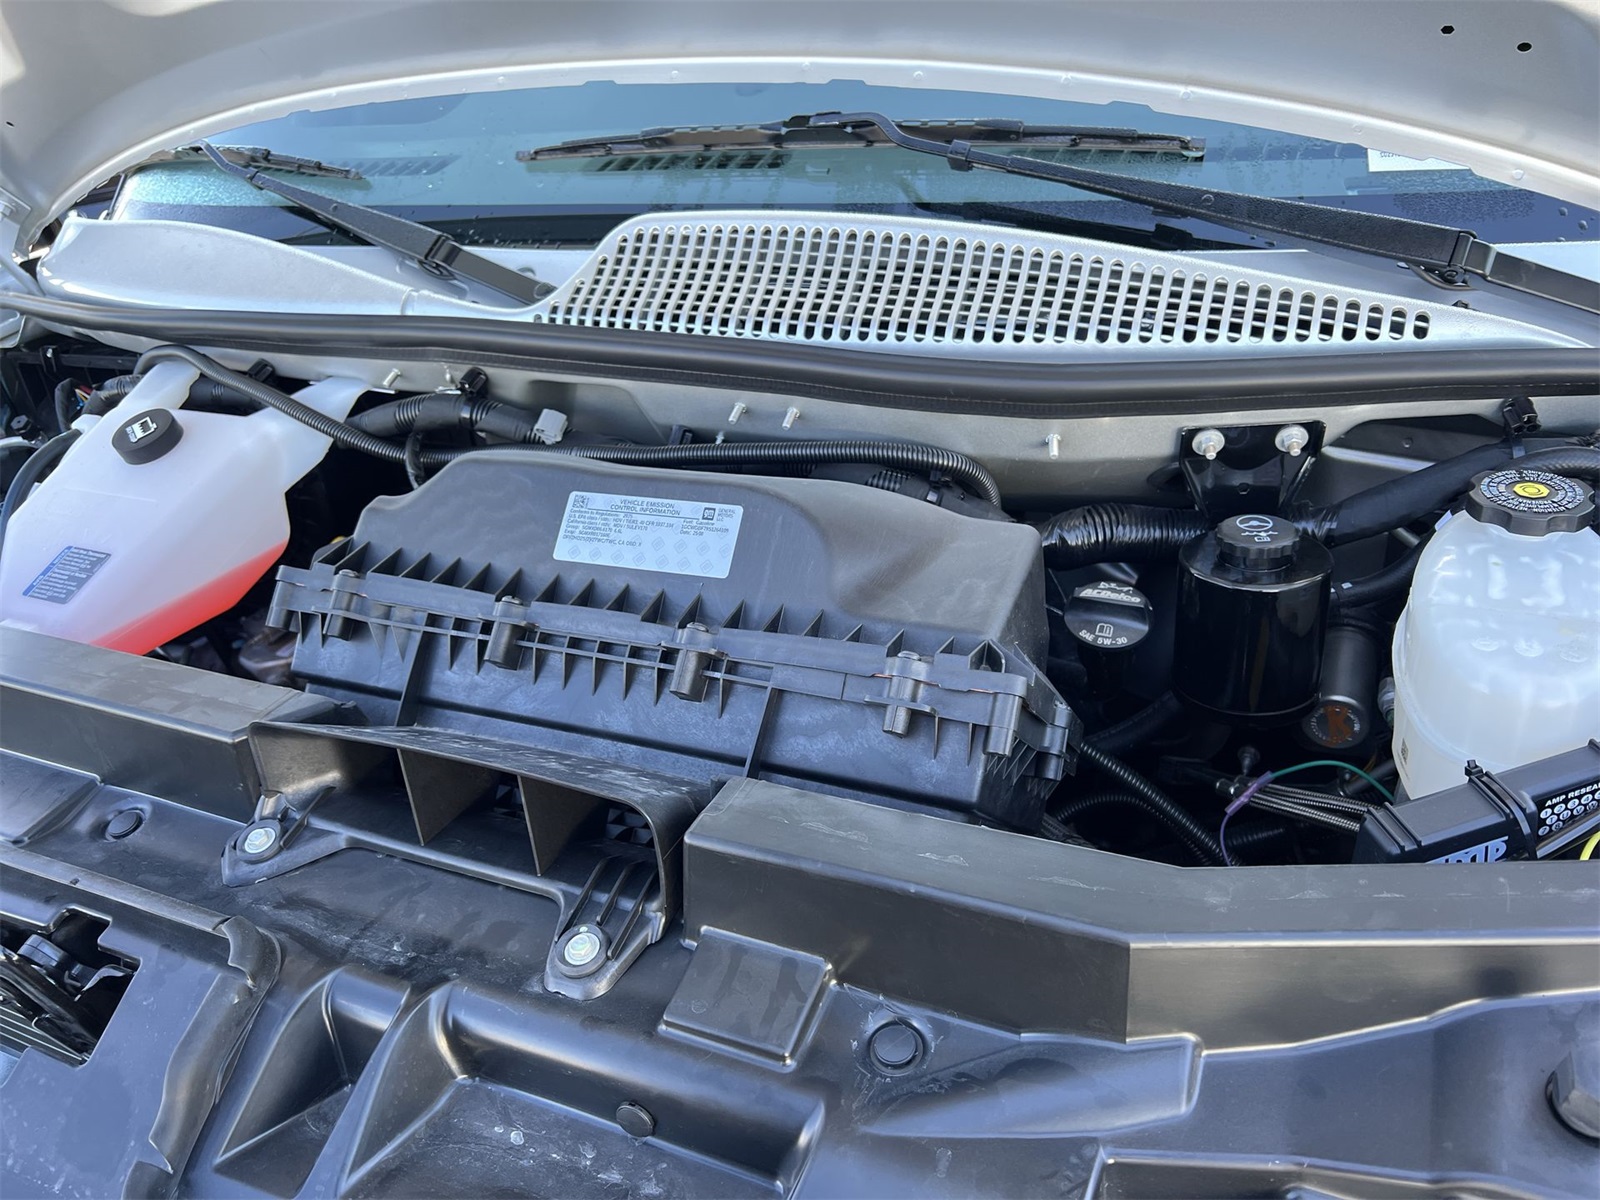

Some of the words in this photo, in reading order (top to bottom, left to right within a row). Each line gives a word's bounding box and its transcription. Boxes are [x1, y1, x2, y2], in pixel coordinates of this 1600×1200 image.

[1079, 588, 1141, 603] ACDelco
[1079, 629, 1096, 642] SAE
[1097, 636, 1128, 646] 5W-30
[1545, 795, 1566, 807] AMP
[1568, 782, 1600, 799] RESEA
